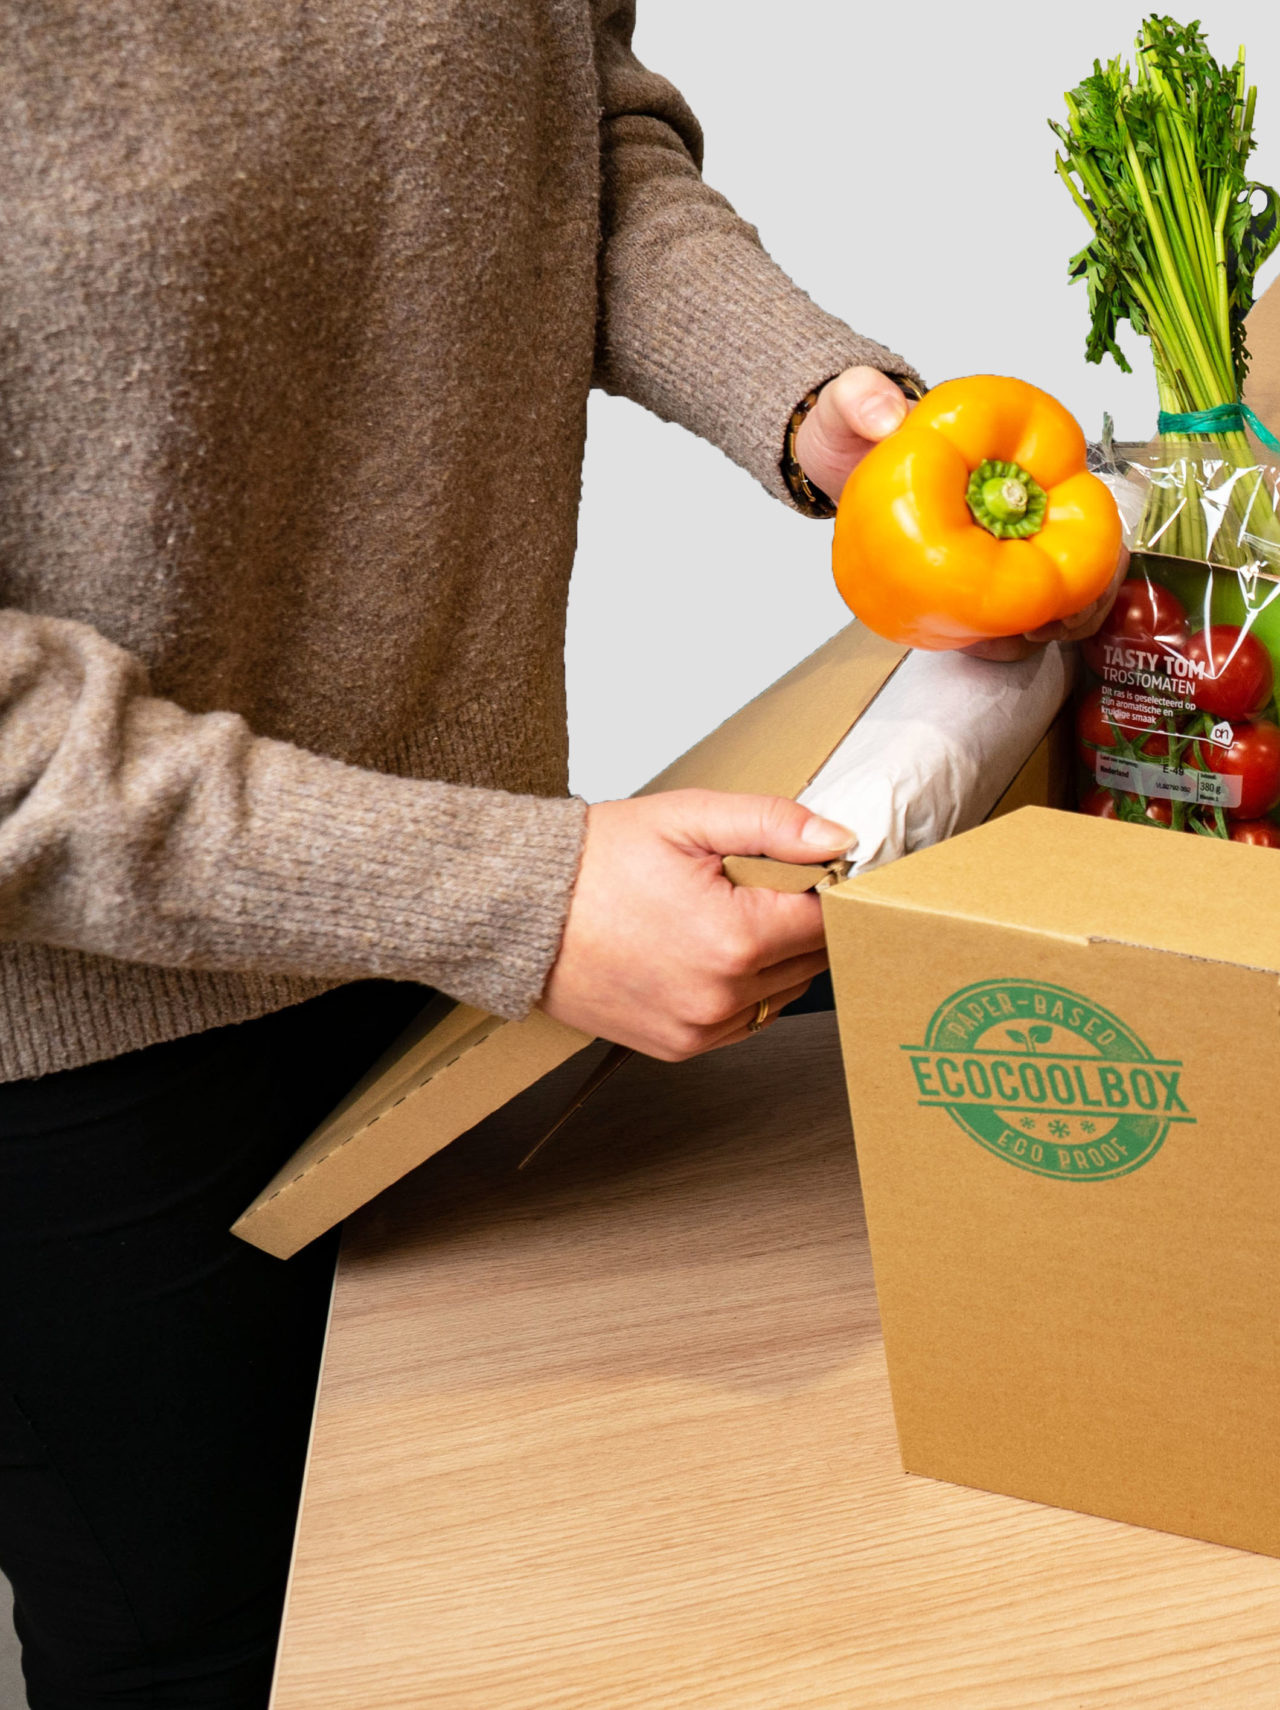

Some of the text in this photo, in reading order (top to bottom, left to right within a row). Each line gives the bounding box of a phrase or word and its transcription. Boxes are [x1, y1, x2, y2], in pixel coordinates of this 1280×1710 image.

[1103, 645, 1206, 680] TASTY TOM
[1102, 666, 1196, 696] TROSTOMATEN
[1101, 686, 1197, 711] Dit ras is geselecteerd op
[1101, 696, 1174, 717] zijn aromatische en
[1101, 705, 1157, 724] kruidige smaak
[1200, 781, 1215, 792] 380
[948, 992, 1117, 1046] PAPER-BASED
[909, 1055, 1190, 1113] ECOCOOLBOX
[997, 1129, 1129, 1171] ECO PROOF
